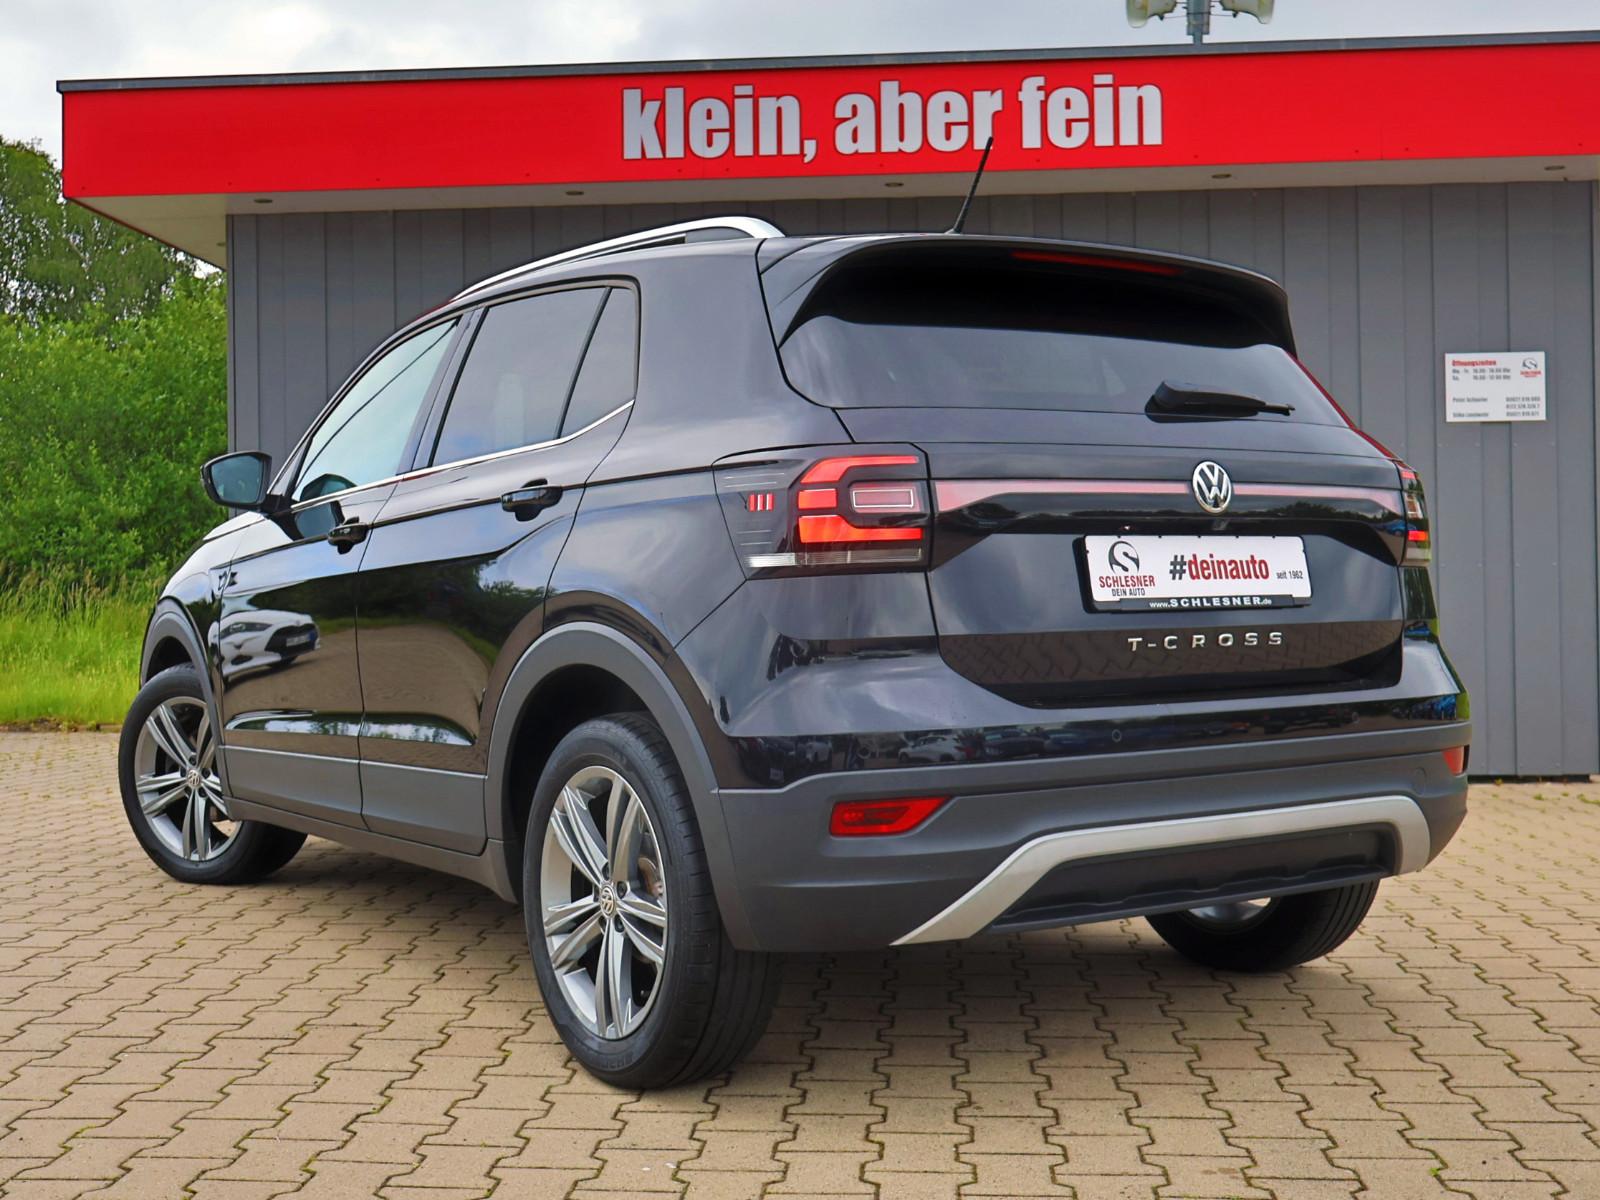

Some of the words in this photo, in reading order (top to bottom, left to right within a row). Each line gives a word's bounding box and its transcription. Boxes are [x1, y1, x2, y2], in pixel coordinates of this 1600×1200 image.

[622, 84, 818, 164] klein,
[833, 80, 1003, 155] aber
[1018, 74, 1163, 150] fein
[1169, 553, 1270, 581] #deinauto
[1098, 575, 1156, 588] SCHLESNER
[1276, 571, 1288, 580] seit
[1111, 587, 1127, 597] DEIN
[1129, 587, 1146, 596] AUTO
[1148, 596, 1272, 608] www.SCHLESNER.de
[1127, 631, 1283, 652] T-CROSS
